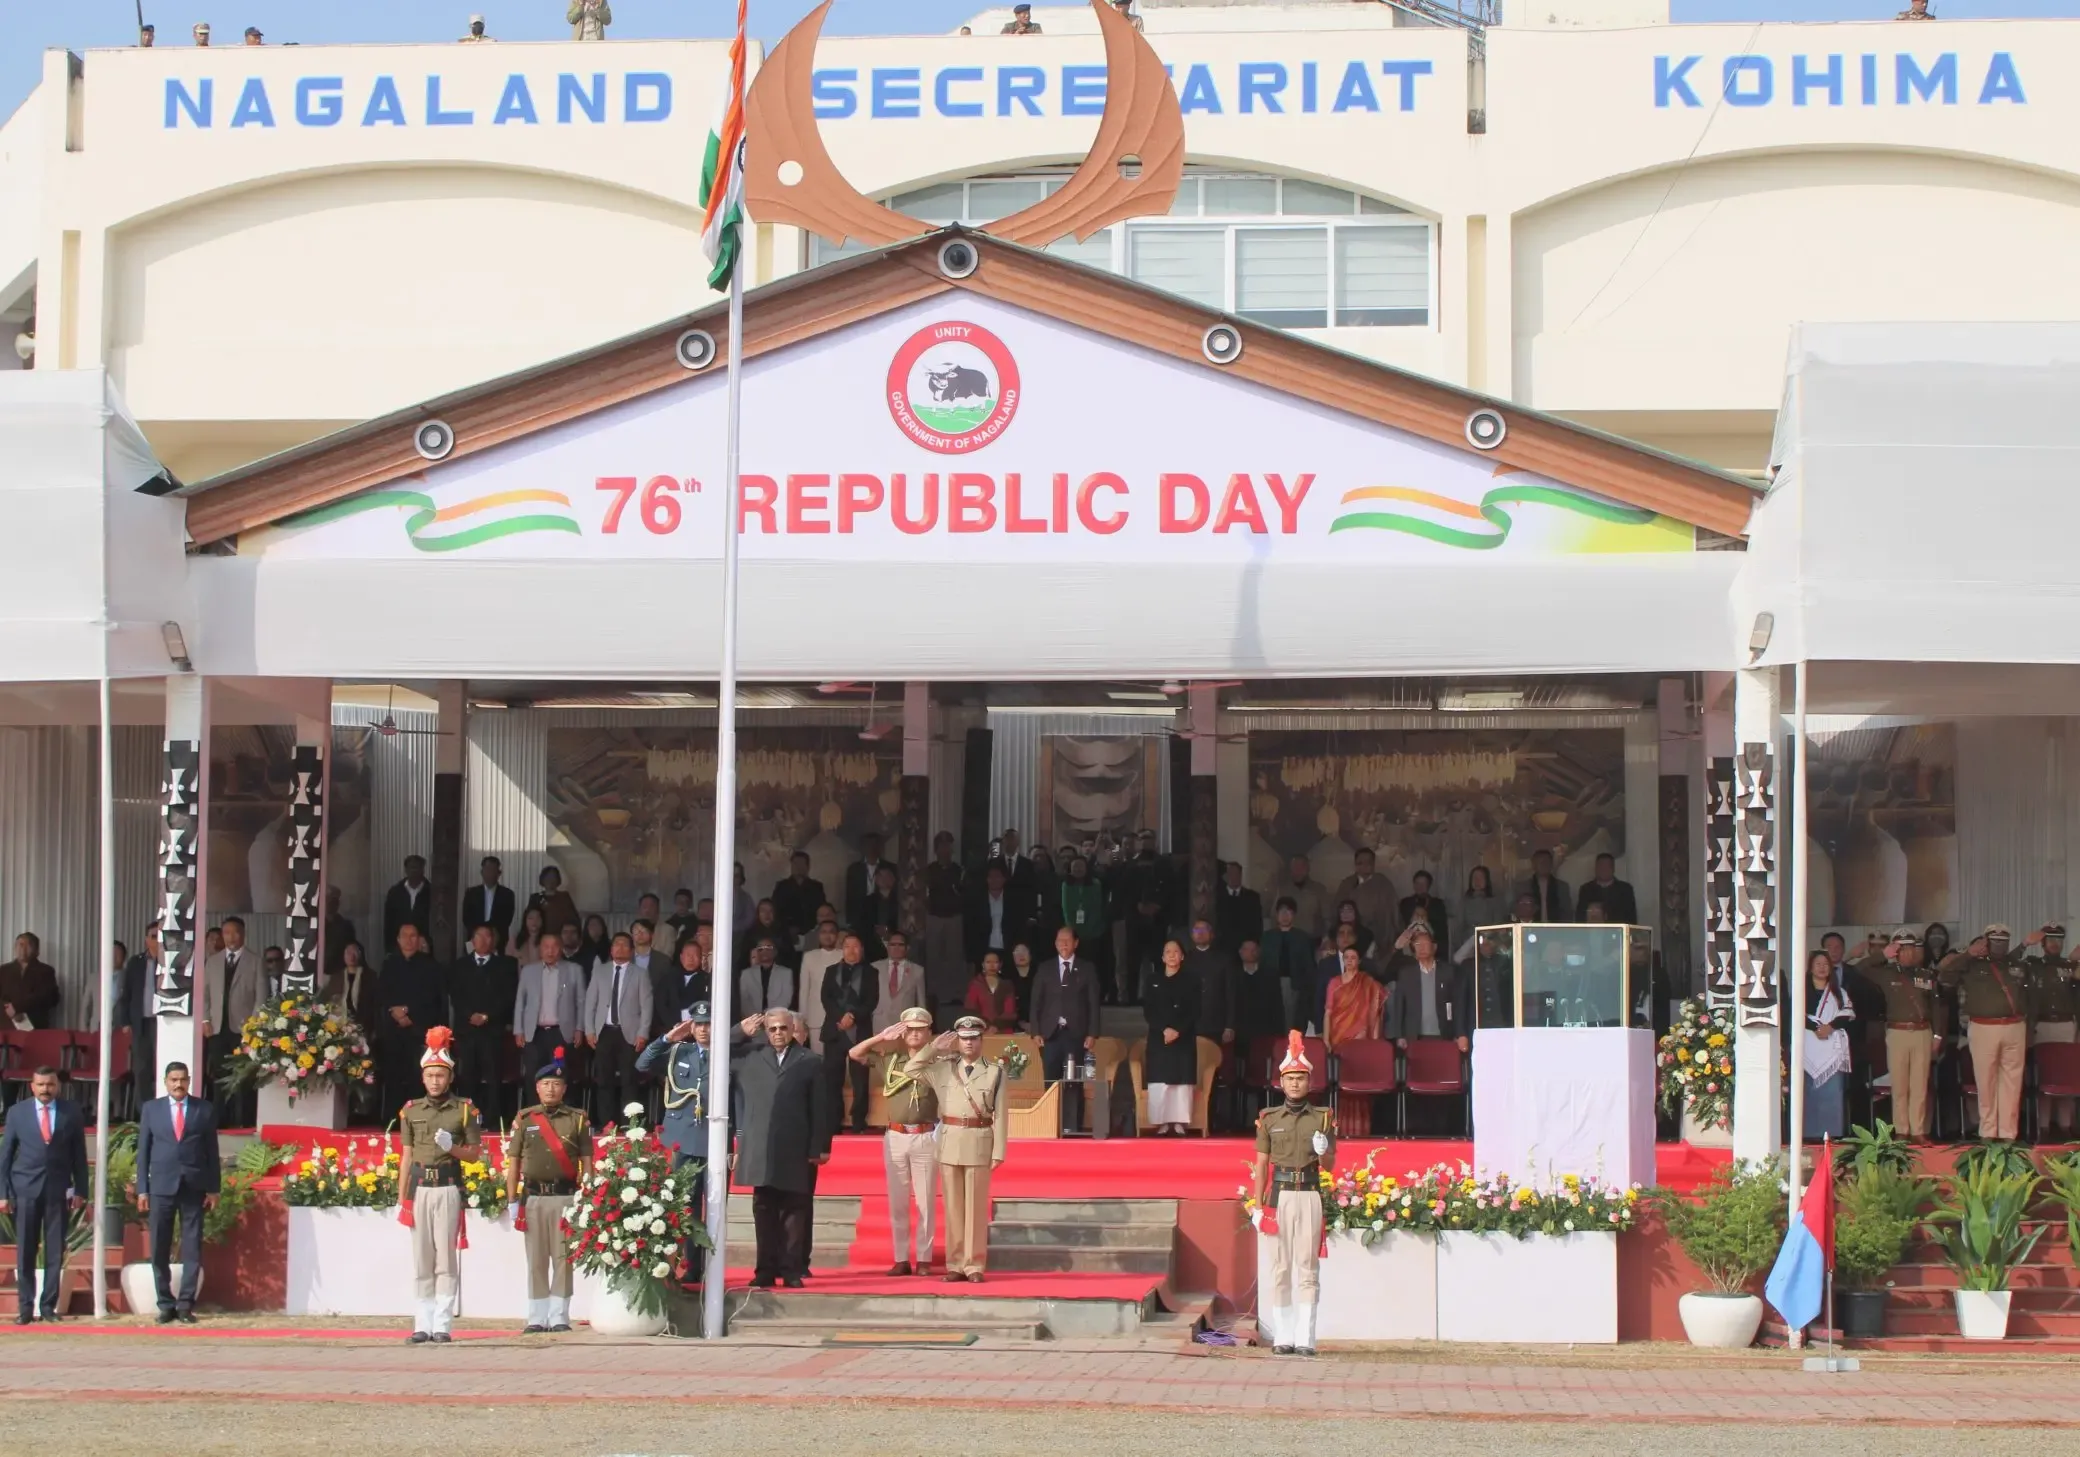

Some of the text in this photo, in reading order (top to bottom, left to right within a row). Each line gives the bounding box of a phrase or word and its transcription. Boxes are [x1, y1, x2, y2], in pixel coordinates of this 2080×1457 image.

[164, 51, 2027, 128] NAGALAND SECREARIAT KOHIMA
[935, 326, 971, 338] UNITY
[891, 389, 1016, 449] GOVERNMENT OF NAGALAND
[595, 472, 1315, 535] 76th REPUBLIC DAY
